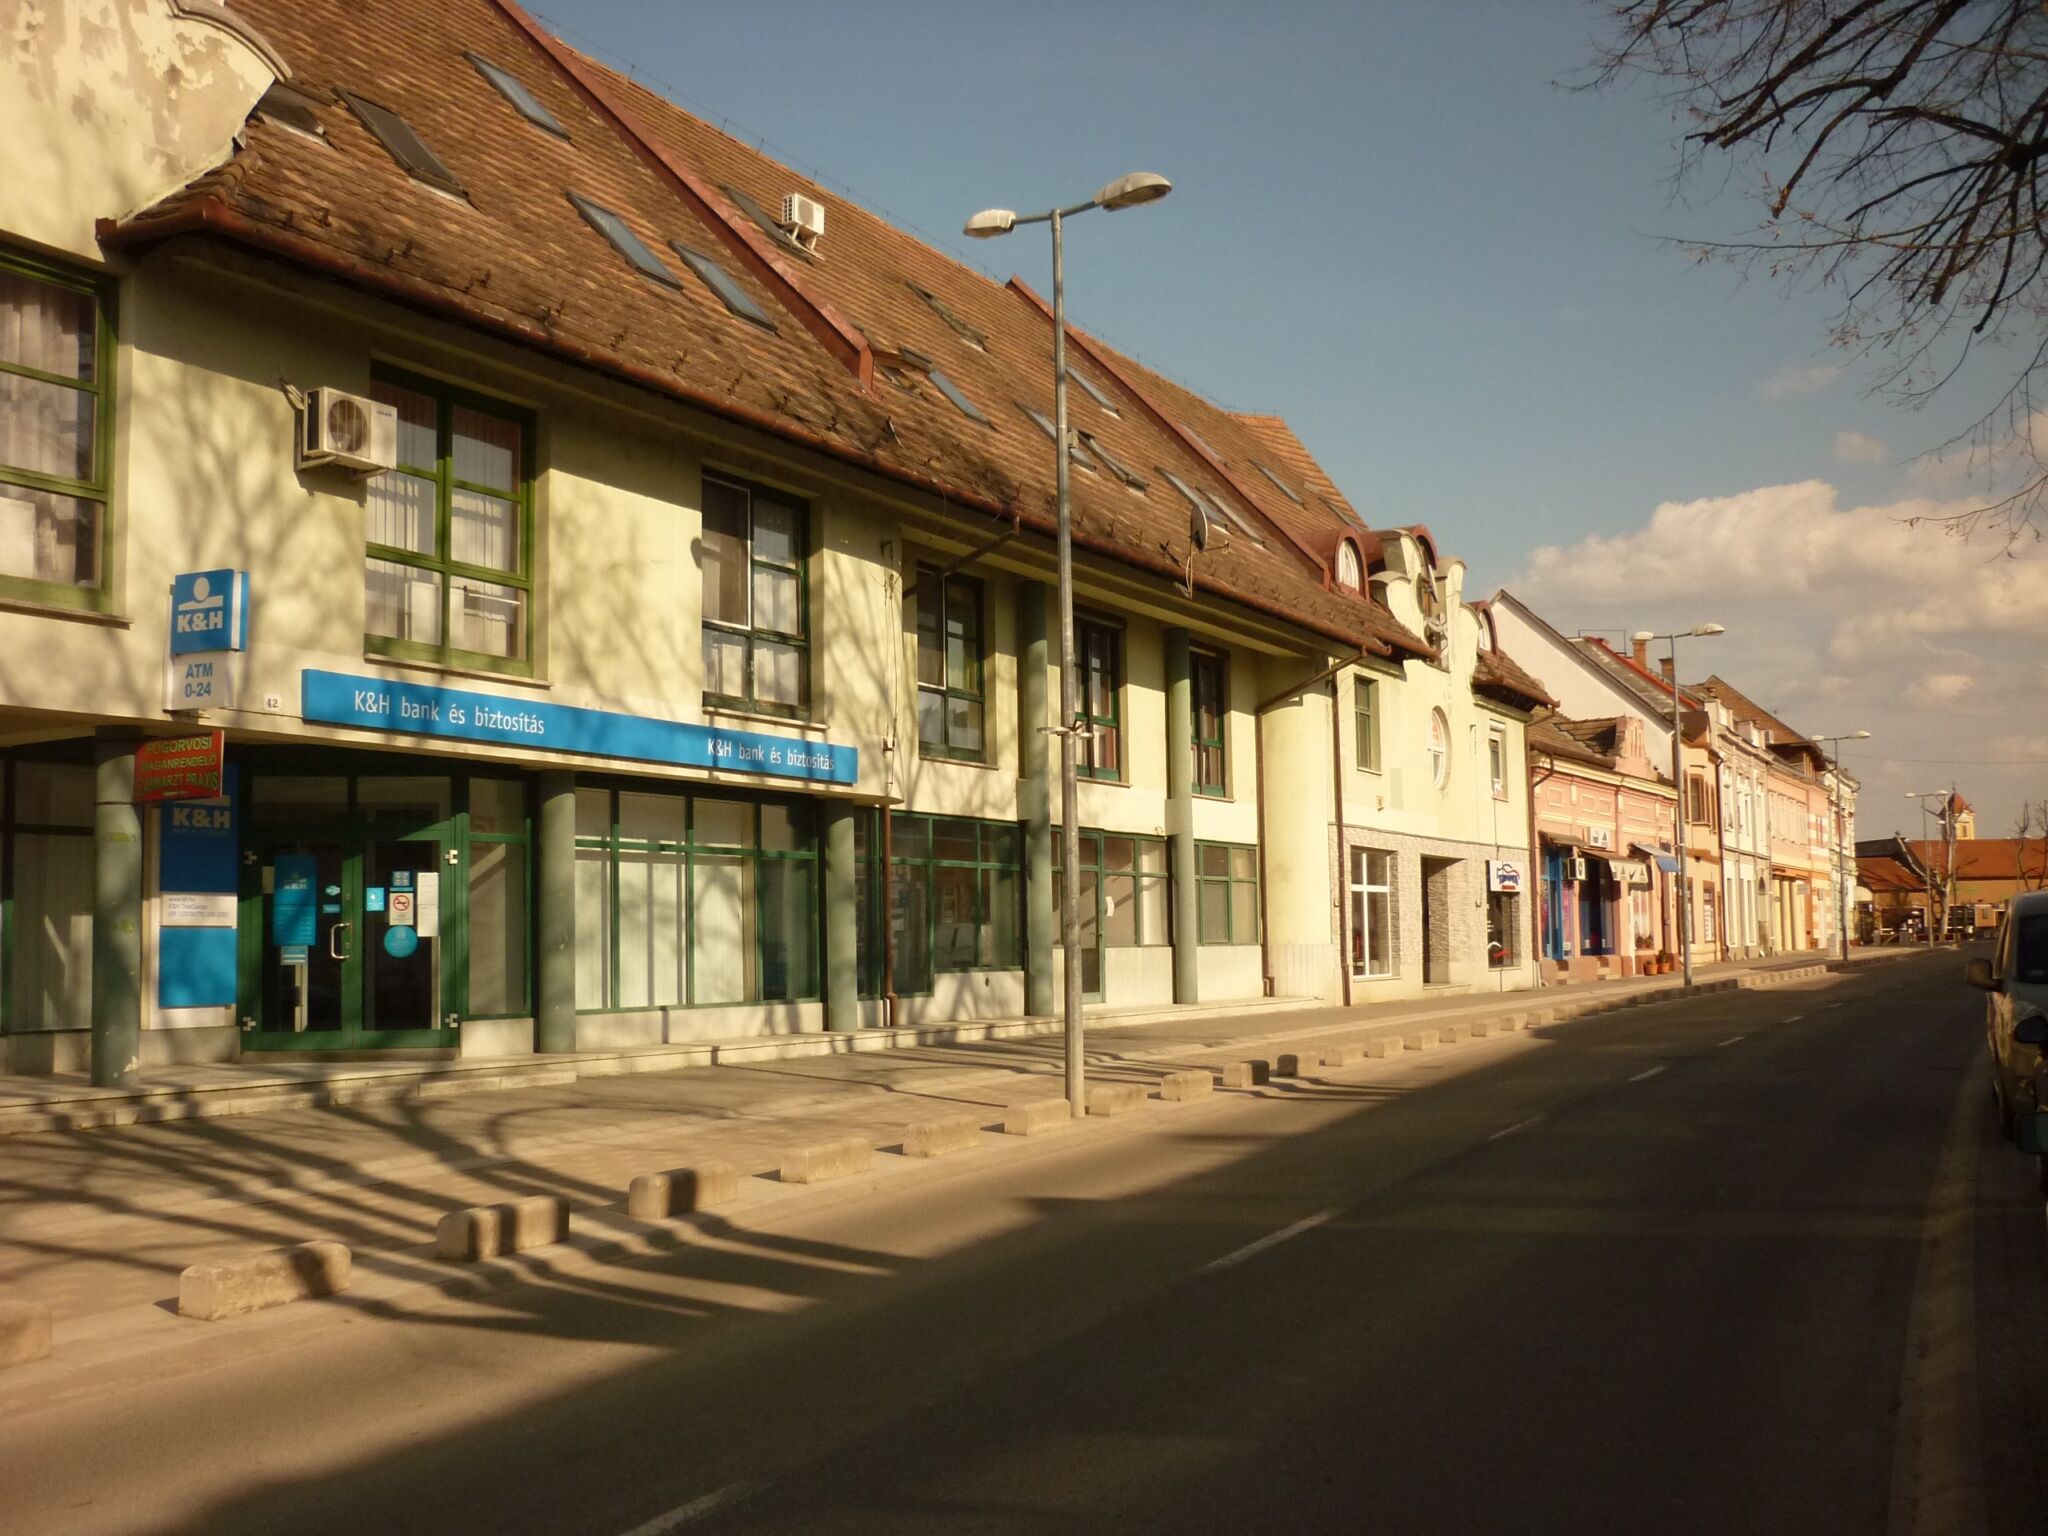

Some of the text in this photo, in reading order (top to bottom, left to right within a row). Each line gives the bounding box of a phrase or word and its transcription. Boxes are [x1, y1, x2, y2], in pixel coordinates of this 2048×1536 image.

[177, 611, 223, 633] K&H
[185, 662, 213, 679] ATM
[184, 682, 212, 698] 0-24
[266, 698, 279, 708] 42
[354, 690, 545, 734] K&H bank és biztosítás
[708, 738, 834, 771] K&H bank és biztosítás
[172, 807, 231, 829] K&H
